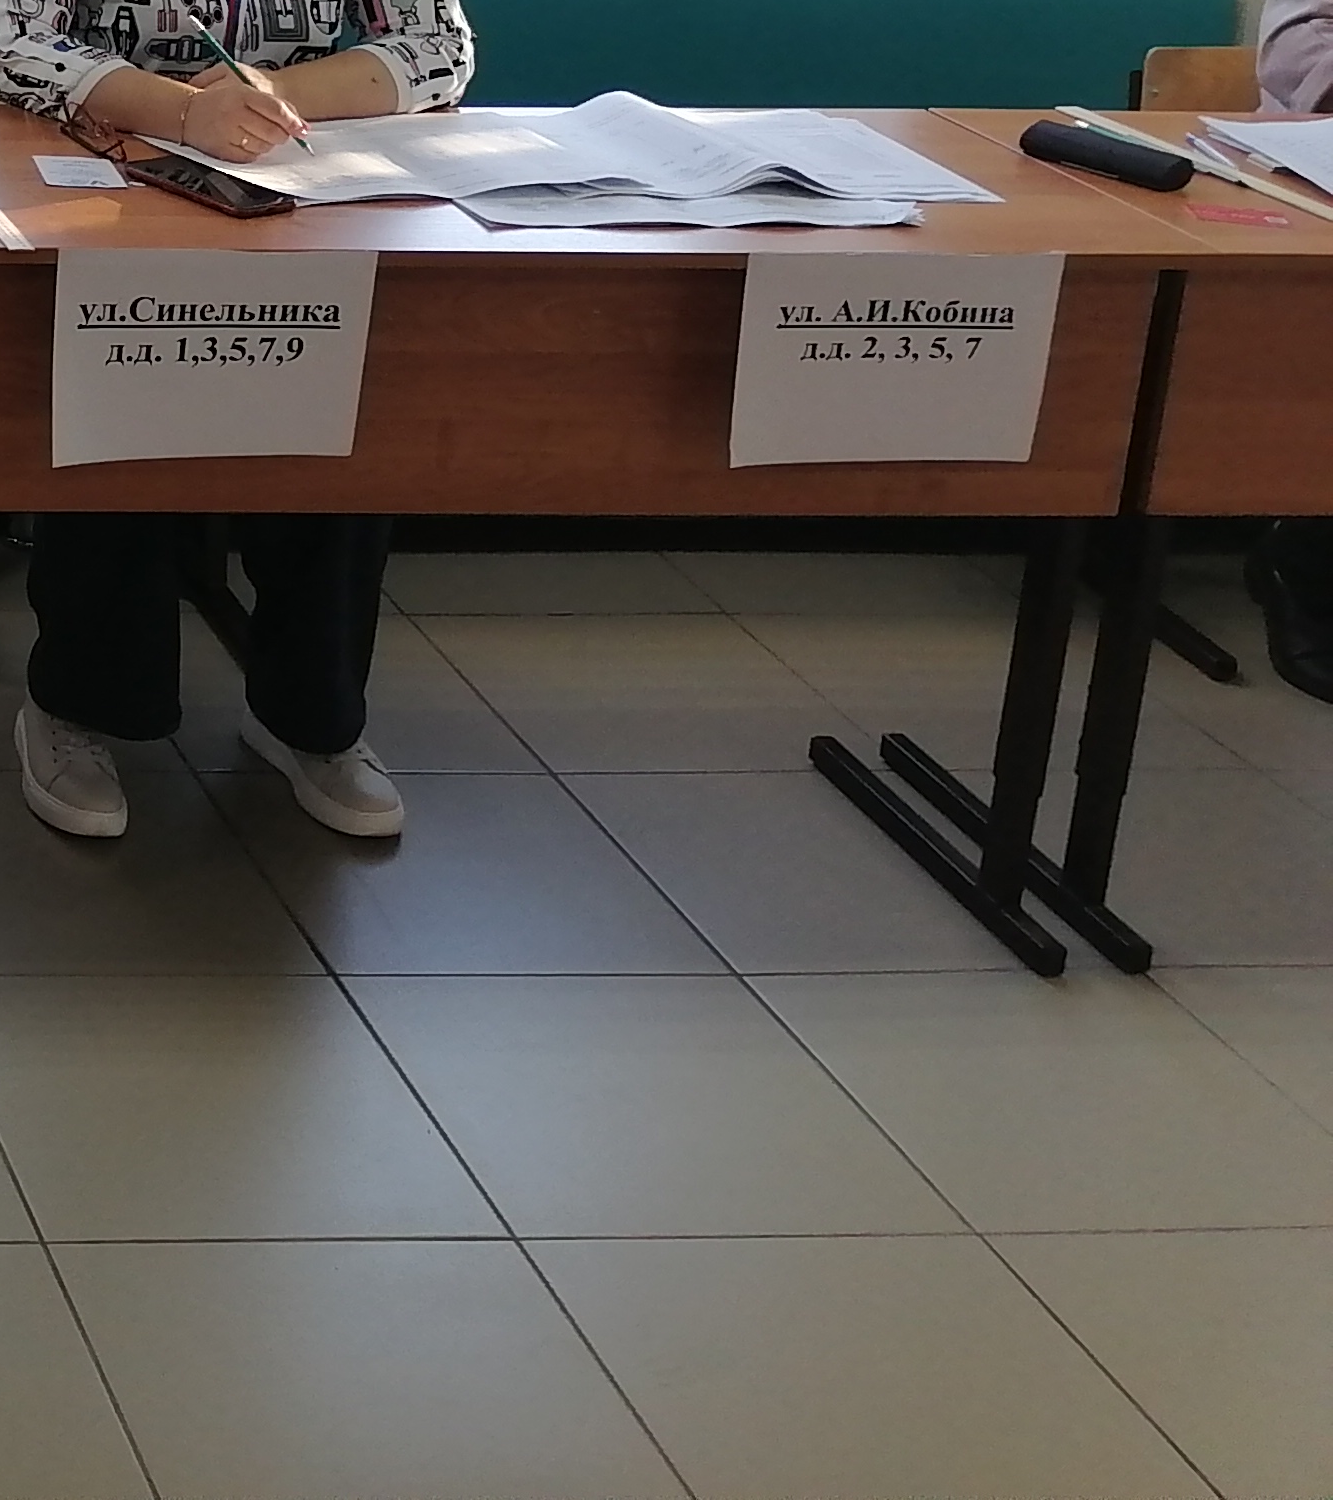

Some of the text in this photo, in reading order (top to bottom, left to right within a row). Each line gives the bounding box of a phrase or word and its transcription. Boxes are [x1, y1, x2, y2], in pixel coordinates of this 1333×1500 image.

[78, 295, 342, 327] ул.Синельника
[779, 298, 1015, 326] ул. А.И.Кобина
[104, 335, 306, 368] д.д. 1,3,5,7,9
[798, 335, 984, 364] д.д. 2, 3, 5, 7
